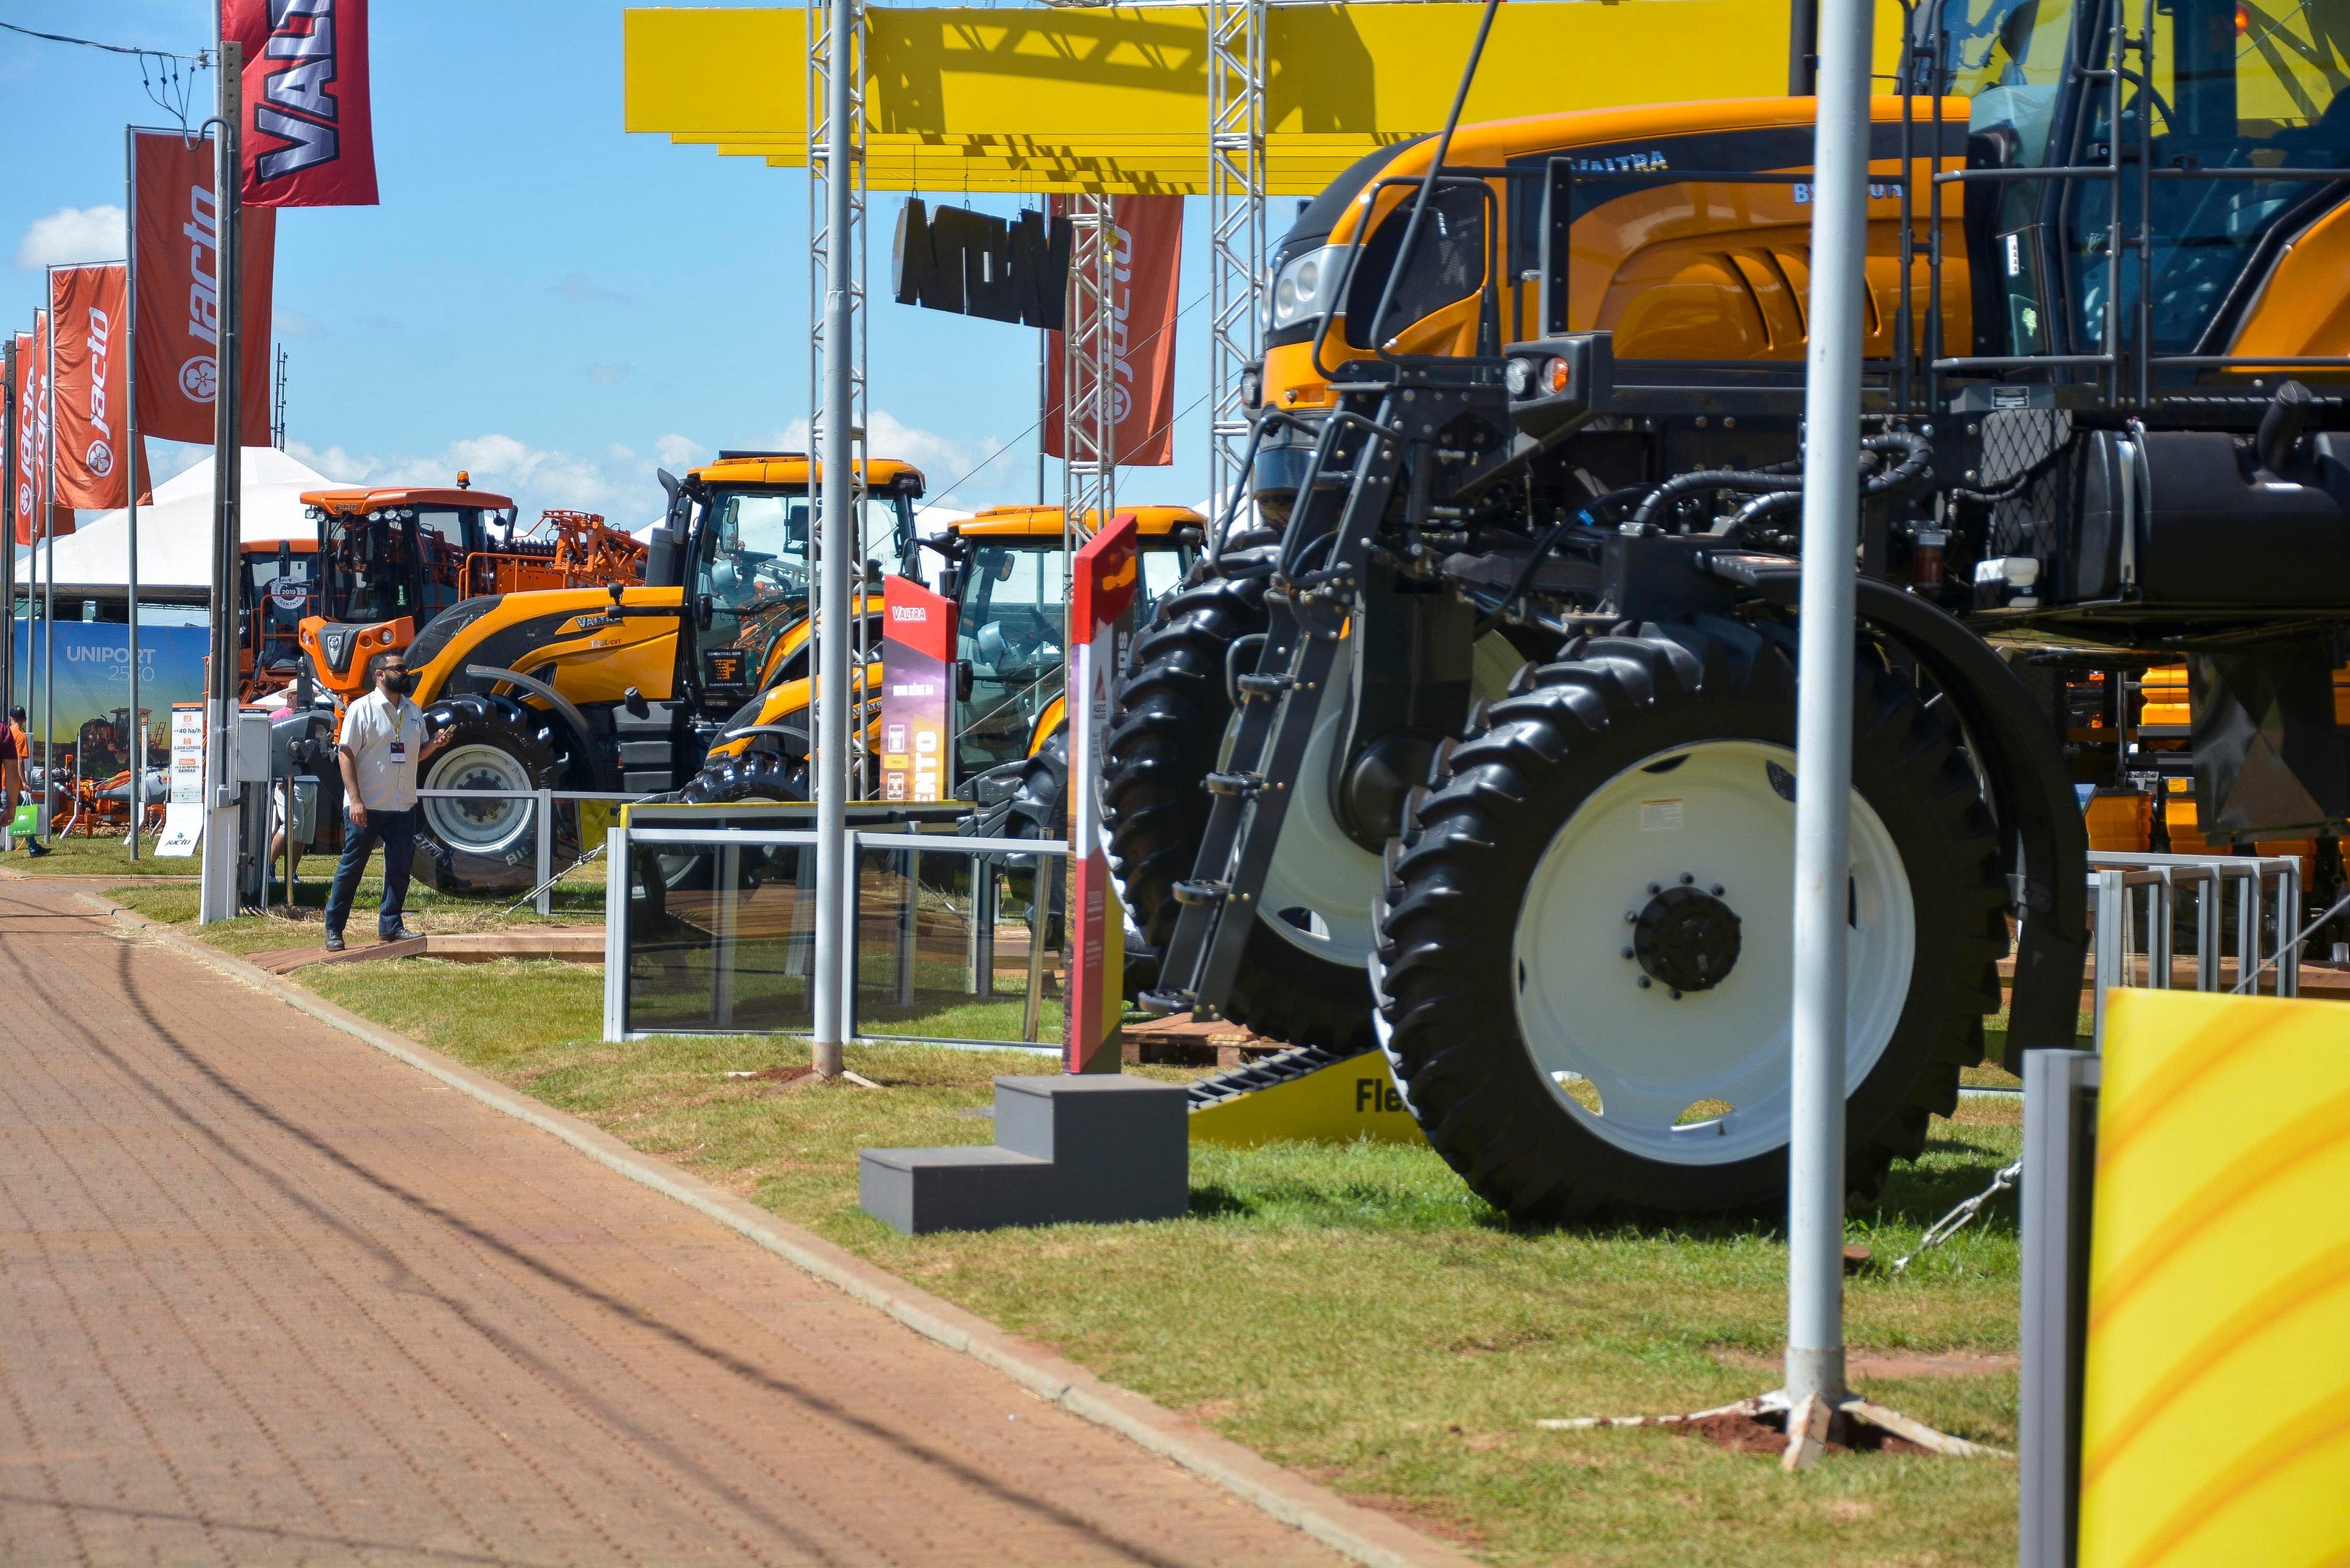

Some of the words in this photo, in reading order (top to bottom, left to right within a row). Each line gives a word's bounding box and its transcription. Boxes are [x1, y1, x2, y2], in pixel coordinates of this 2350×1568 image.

[86, 306, 110, 440] jacto
[892, 606, 927, 621] VALTRA
[1355, 1077, 1409, 1112] Fle
